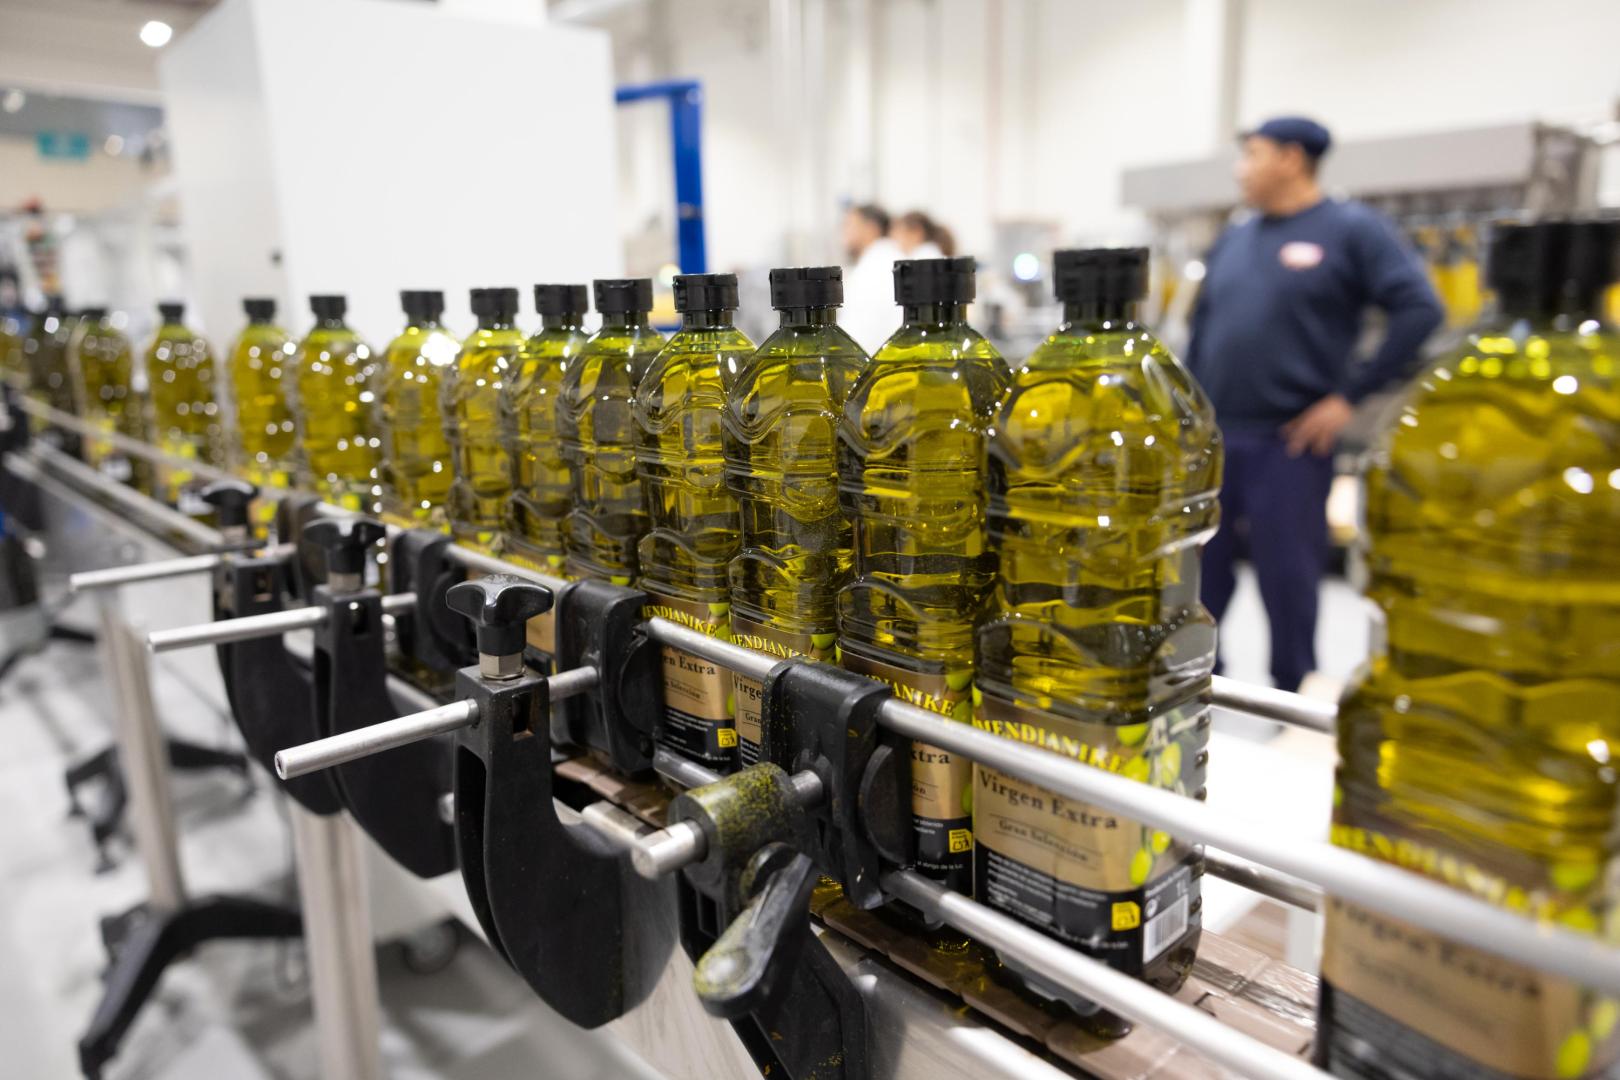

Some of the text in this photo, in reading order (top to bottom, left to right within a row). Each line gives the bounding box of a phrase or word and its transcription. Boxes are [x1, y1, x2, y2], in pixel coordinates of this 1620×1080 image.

[679, 655, 716, 675] Extra
[734, 675, 762, 700] Virge
[980, 770, 1043, 806] Virgen
[1052, 798, 1118, 829] Extra
